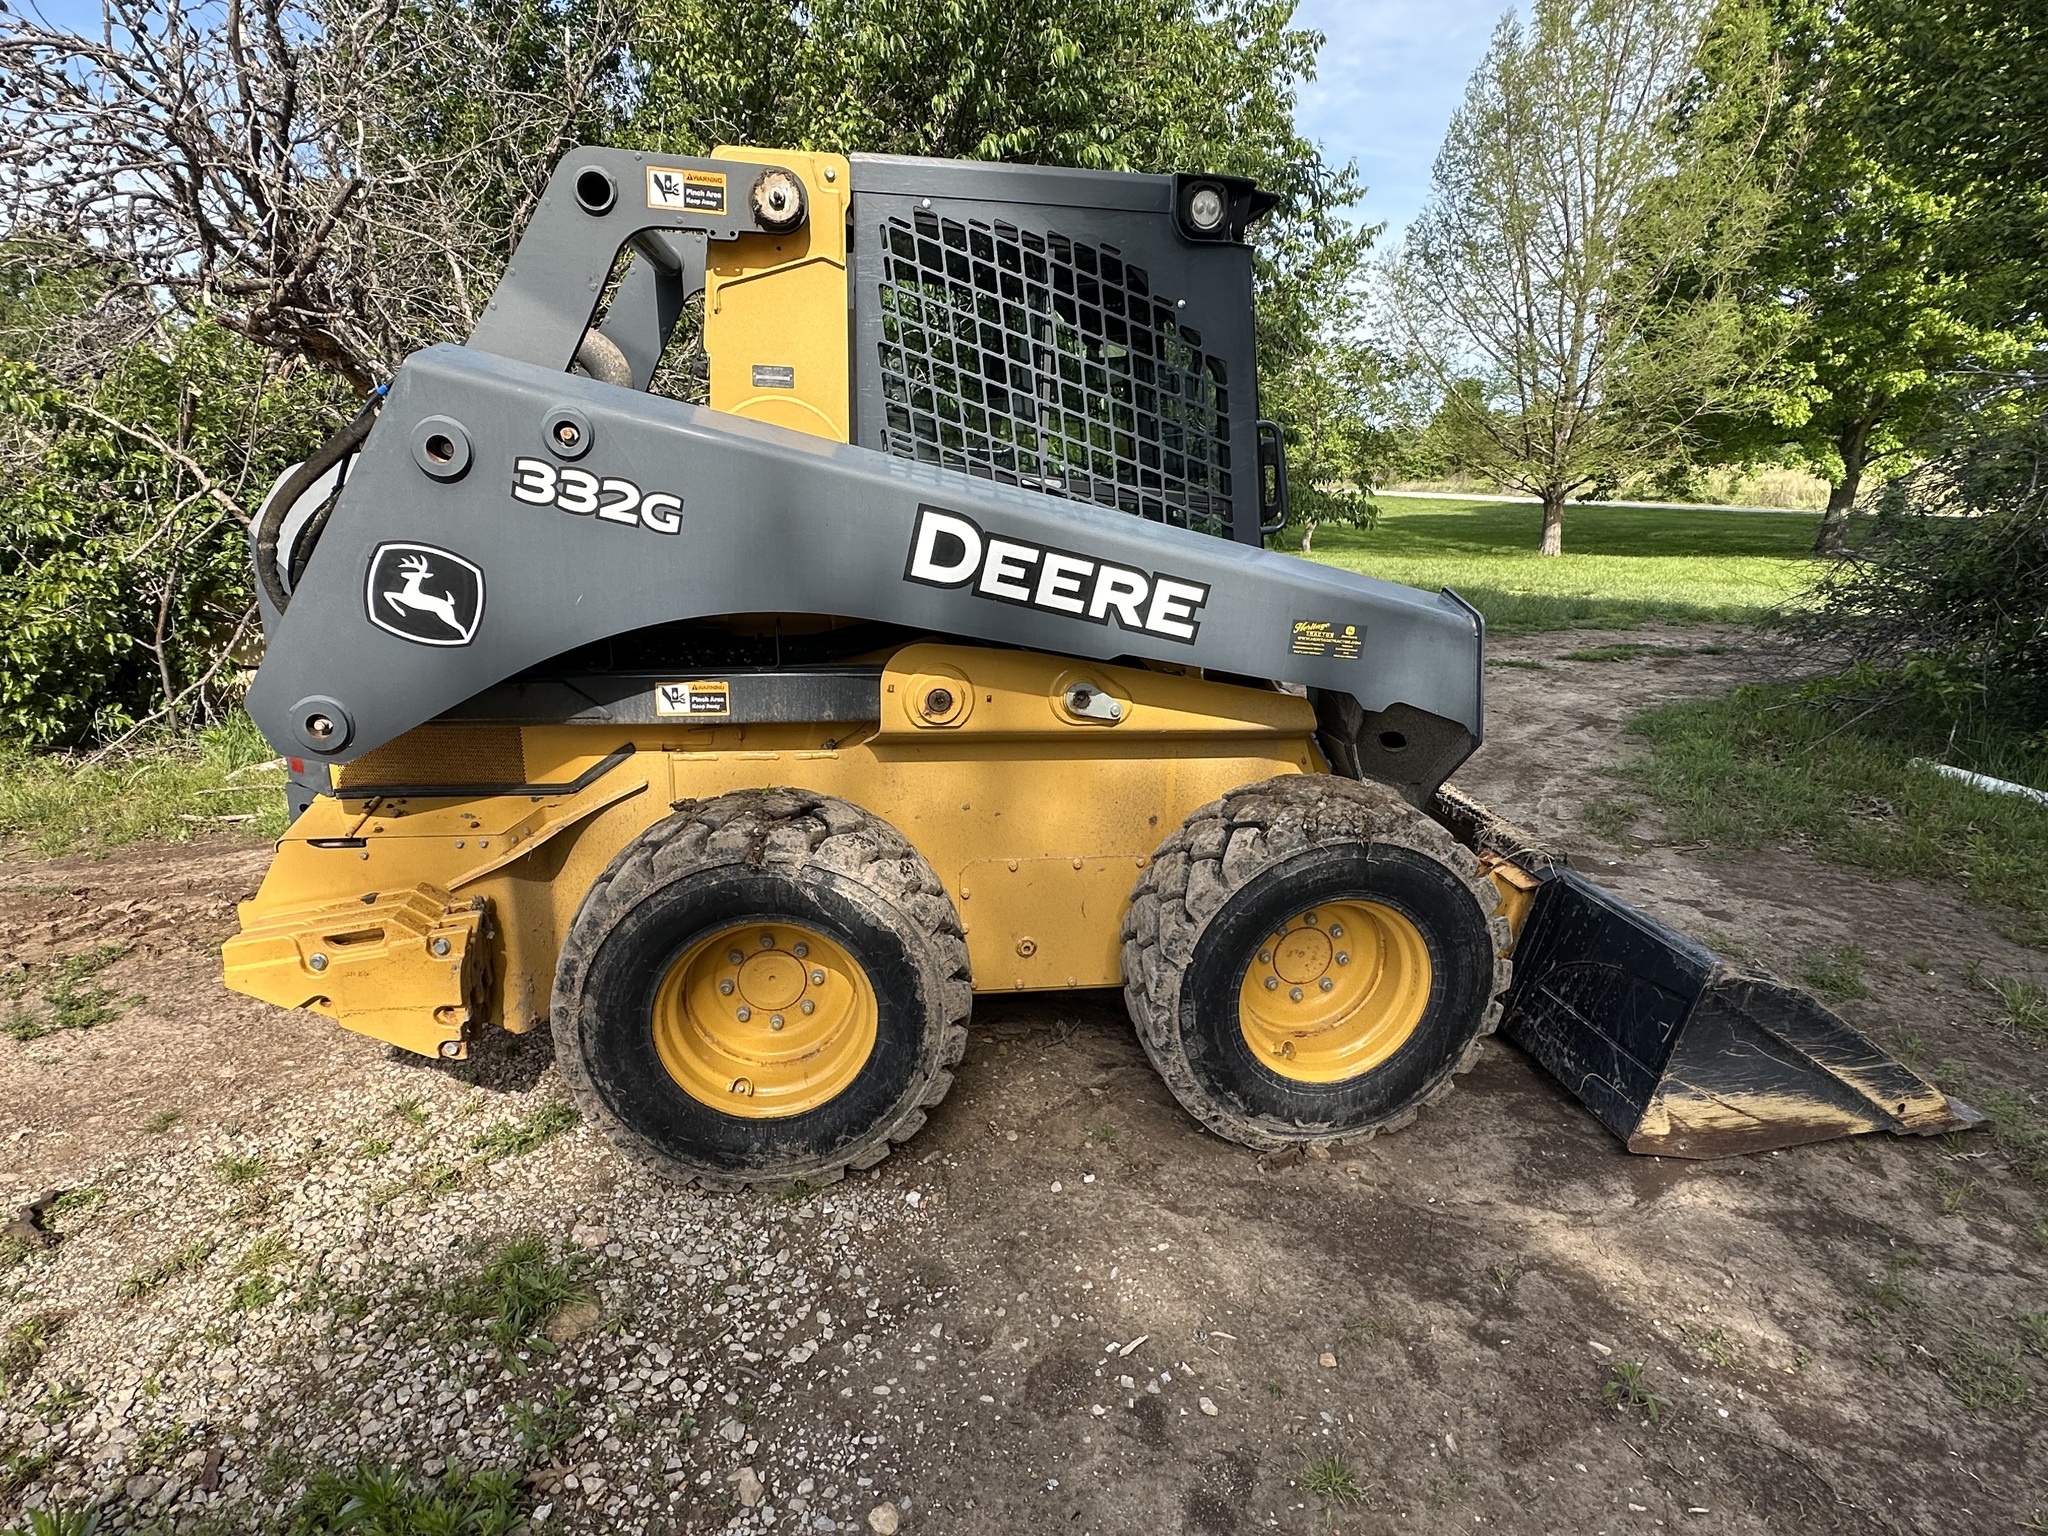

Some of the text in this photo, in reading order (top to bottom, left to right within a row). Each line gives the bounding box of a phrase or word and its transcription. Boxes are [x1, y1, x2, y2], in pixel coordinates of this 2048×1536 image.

[693, 175, 723, 184] WARNING
[686, 188, 722, 199] Pinch Area
[686, 197, 718, 207] Keep Away
[512, 458, 683, 534] 332G
[907, 508, 1207, 641] DEERE
[1293, 621, 1331, 634] Heritage
